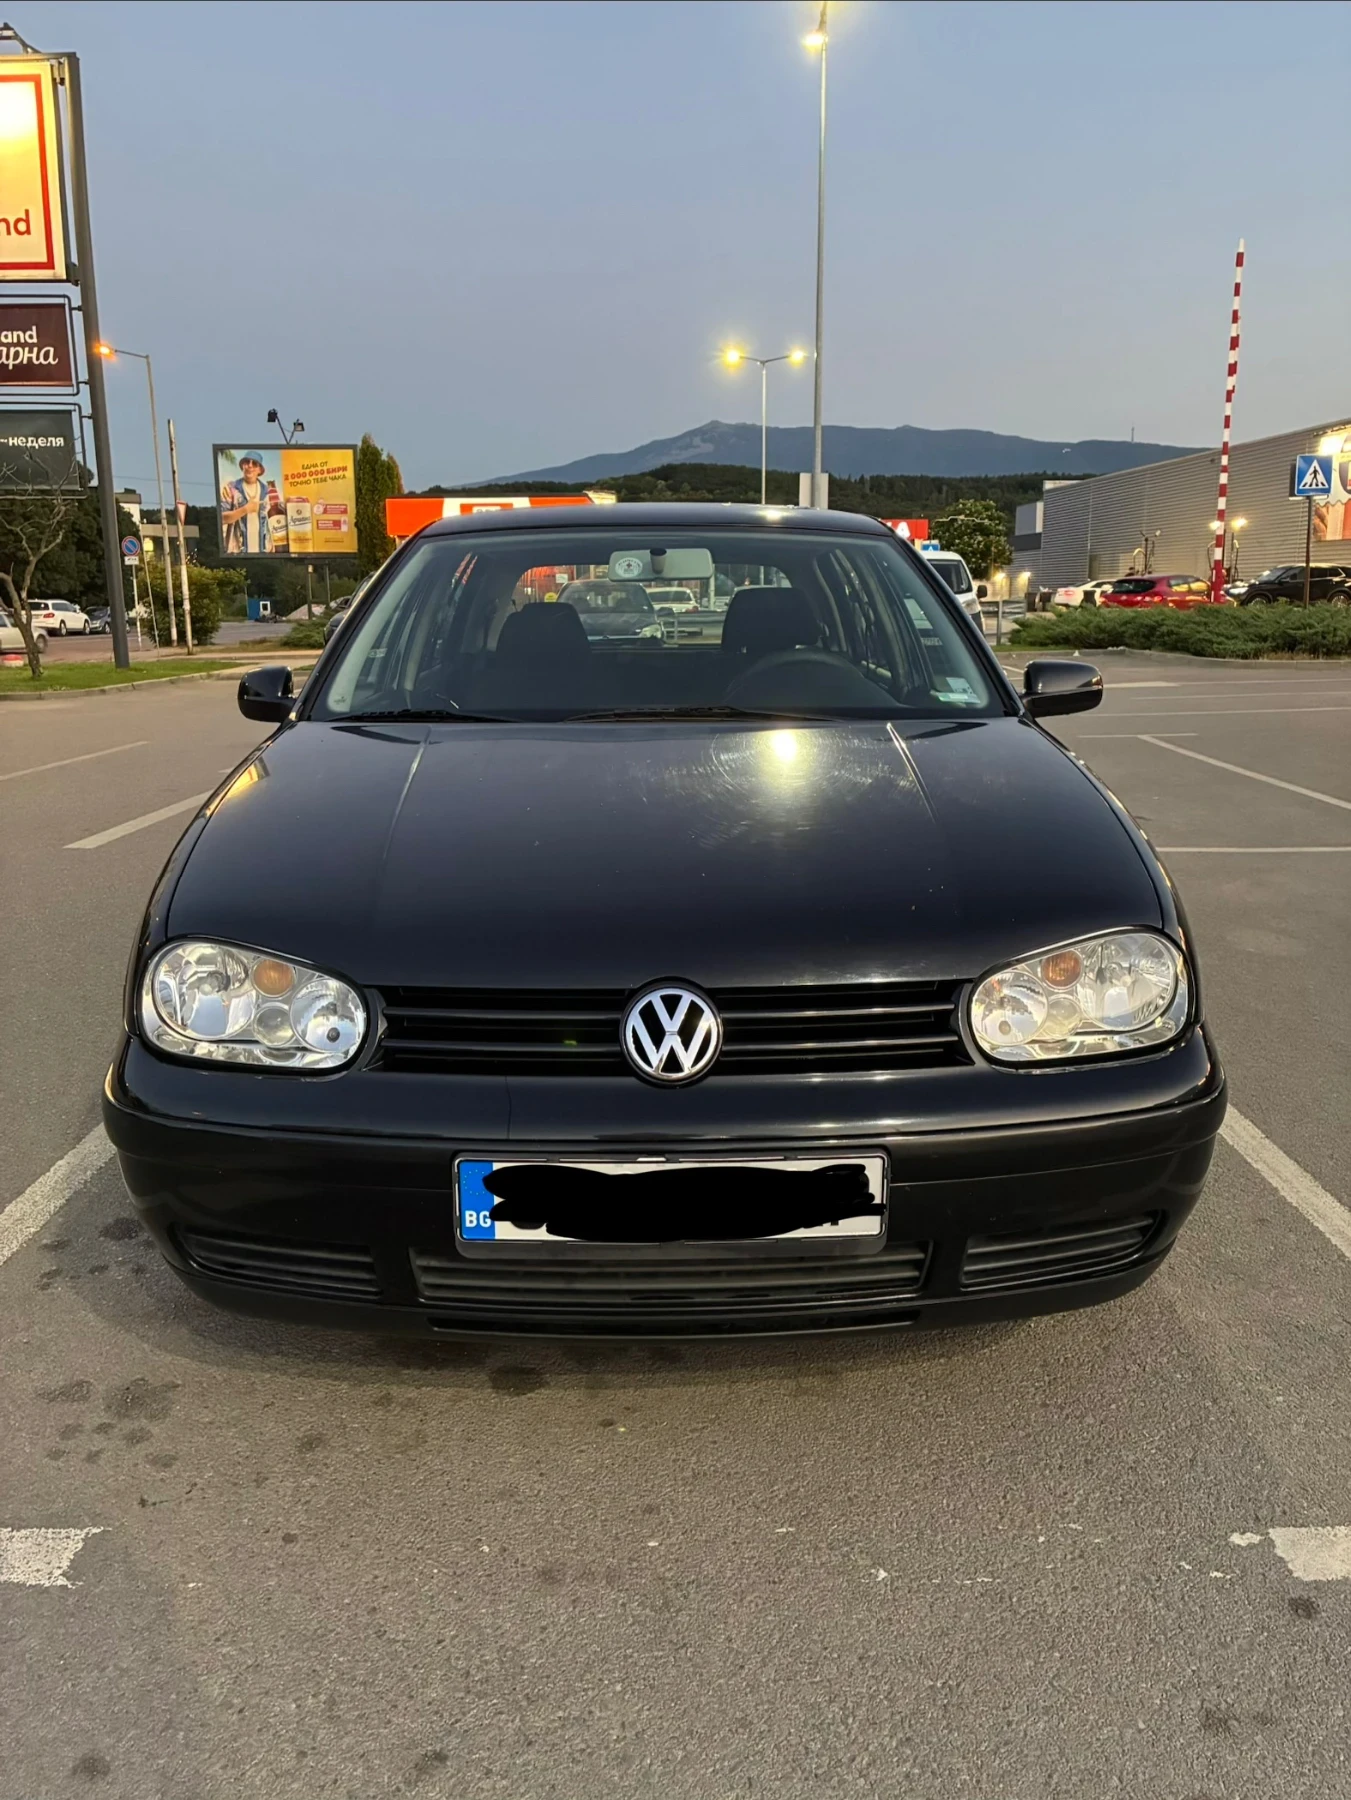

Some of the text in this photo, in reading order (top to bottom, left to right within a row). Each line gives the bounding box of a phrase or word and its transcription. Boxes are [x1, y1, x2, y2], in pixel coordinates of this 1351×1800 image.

[0, 325, 38, 343] and
[284, 465, 348, 481] 2 000 000 БИРИ
[301, 462, 319, 470] ЕДНА
[289, 473, 347, 487] ТОЧНО ТЕБЕ ЧАКА
[465, 1210, 491, 1227] BG
